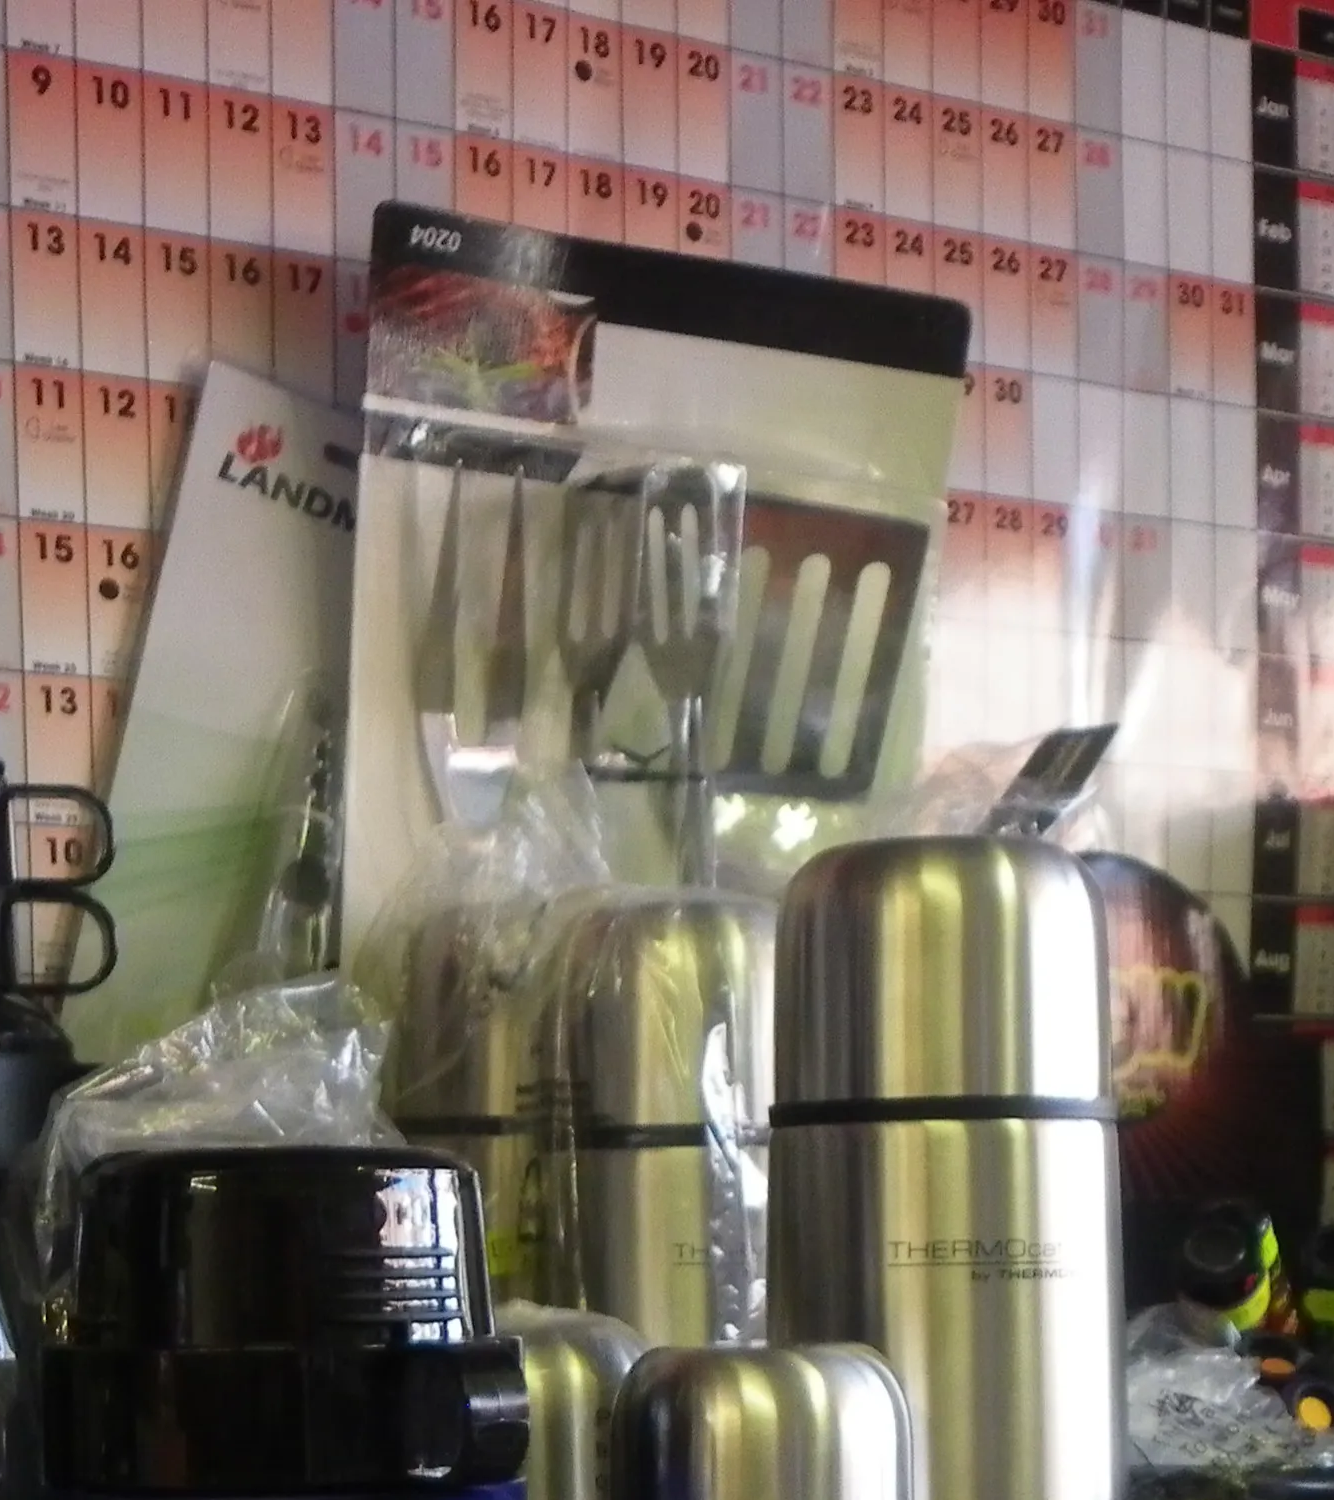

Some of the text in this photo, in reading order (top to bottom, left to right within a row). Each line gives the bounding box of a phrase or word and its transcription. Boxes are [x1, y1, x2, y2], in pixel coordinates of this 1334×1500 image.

[688, 51, 1064, 154] 20 23 25 27
[32, 65, 51, 95] 9
[93, 76, 129, 109] 10
[224, 100, 259, 134] 12
[288, 111, 321, 145] 13
[689, 190, 720, 220] 20
[27, 222, 65, 256] 13
[162, 243, 198, 277] 15
[32, 378, 65, 409] 11
[36, 532, 73, 563] 15
[41, 686, 78, 715] 13
